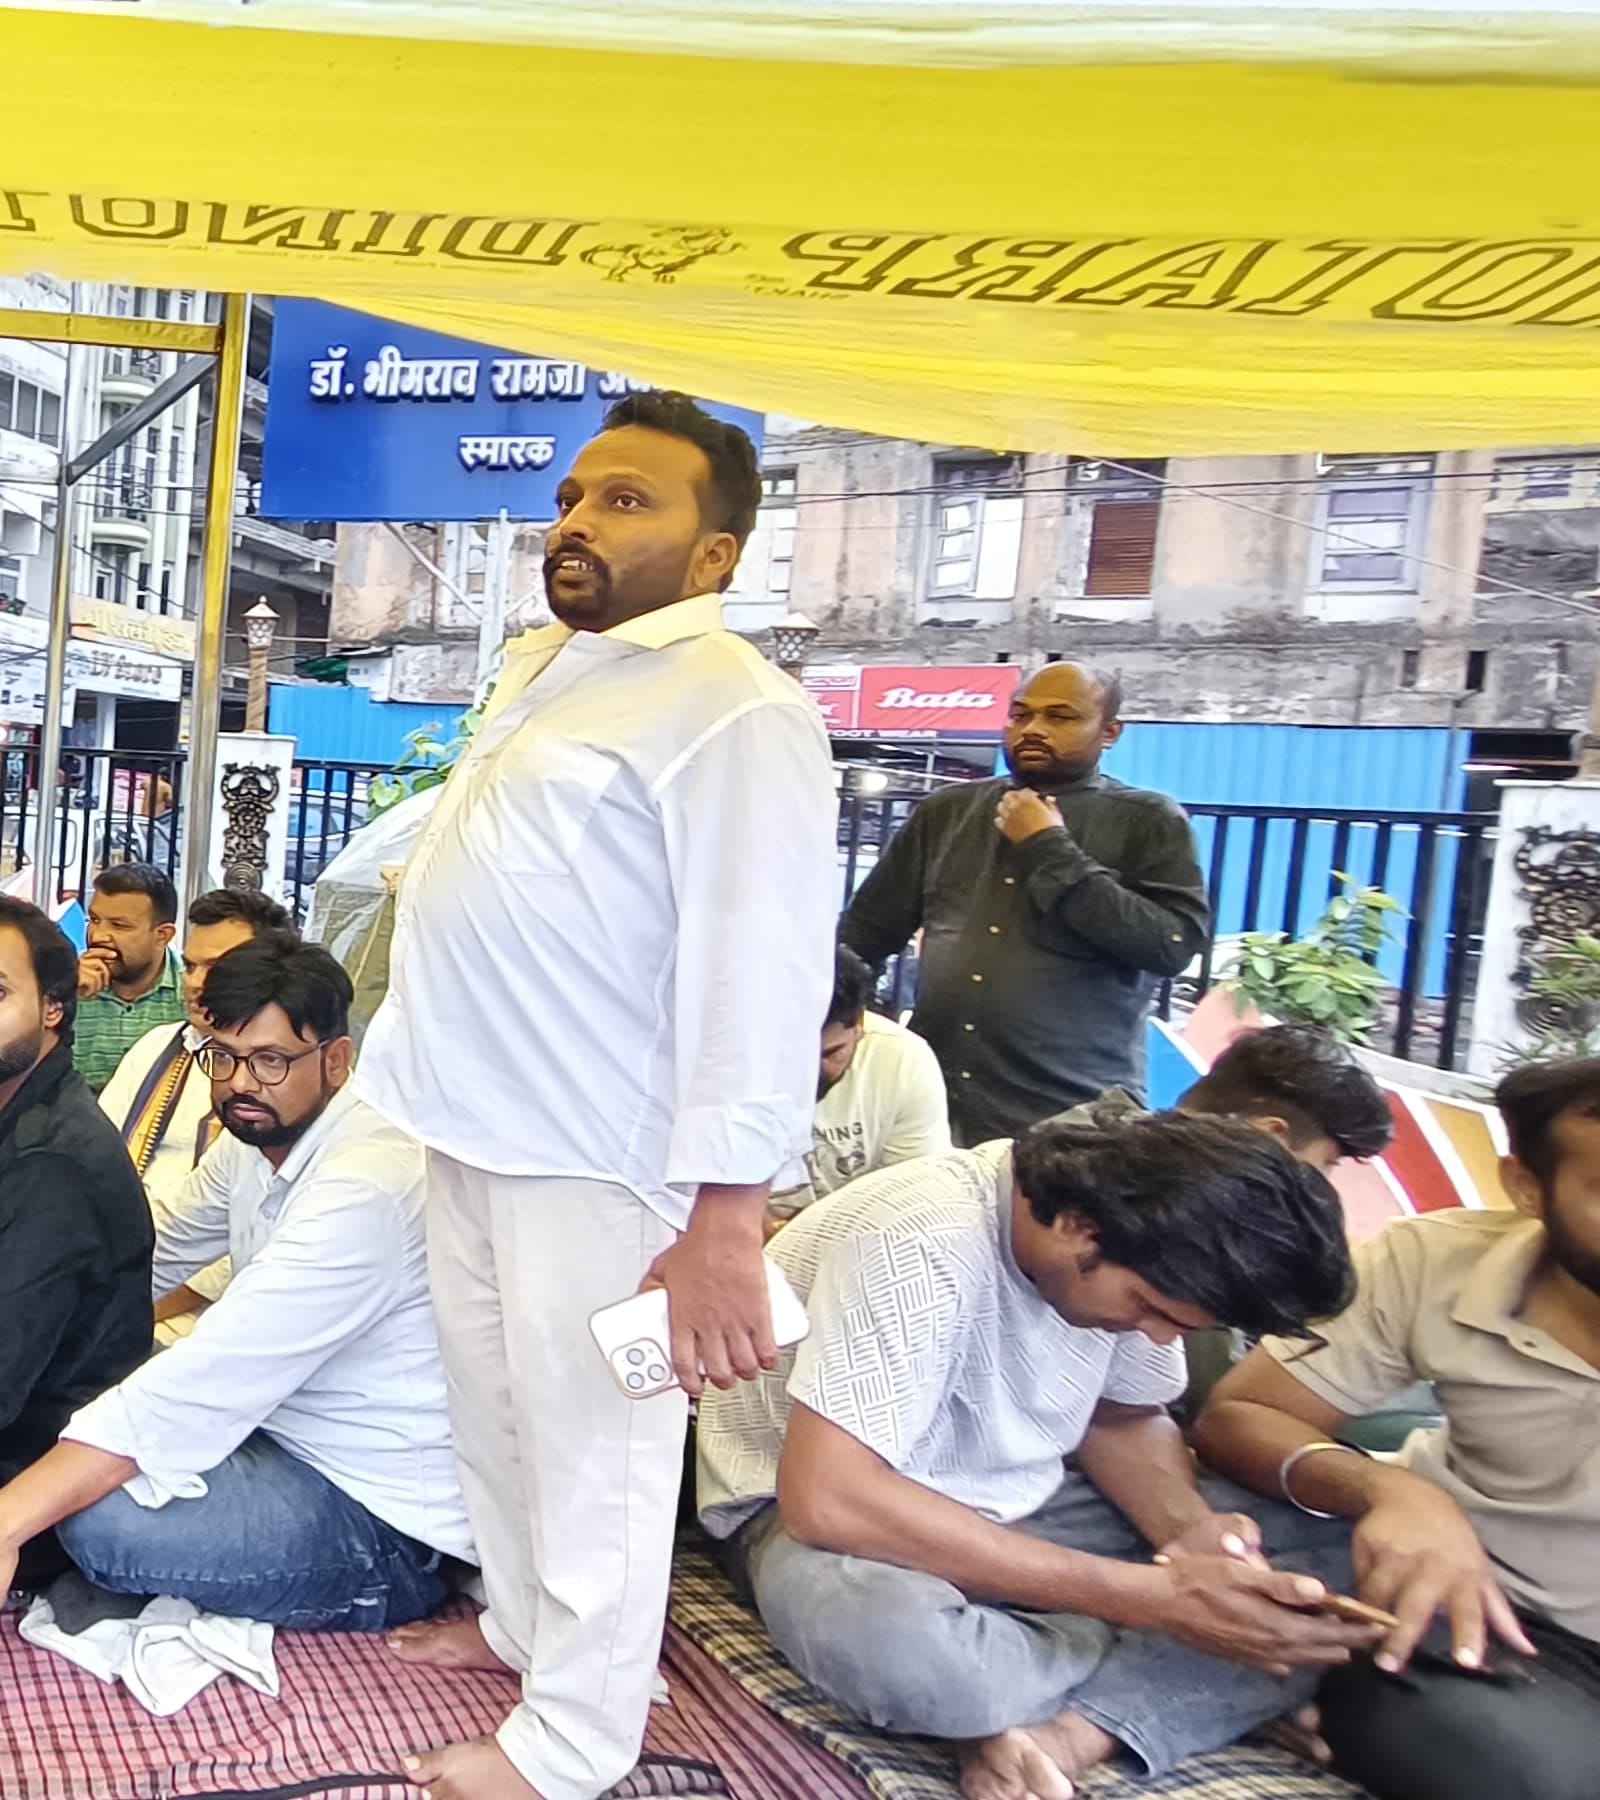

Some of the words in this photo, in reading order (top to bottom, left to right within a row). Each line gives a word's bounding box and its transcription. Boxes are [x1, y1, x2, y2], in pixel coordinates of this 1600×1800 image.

[310, 347, 355, 397] डॉ.
[363, 345, 479, 398] भीमराव
[460, 436, 556, 470] स्मारक
[874, 687, 998, 709] Bata
